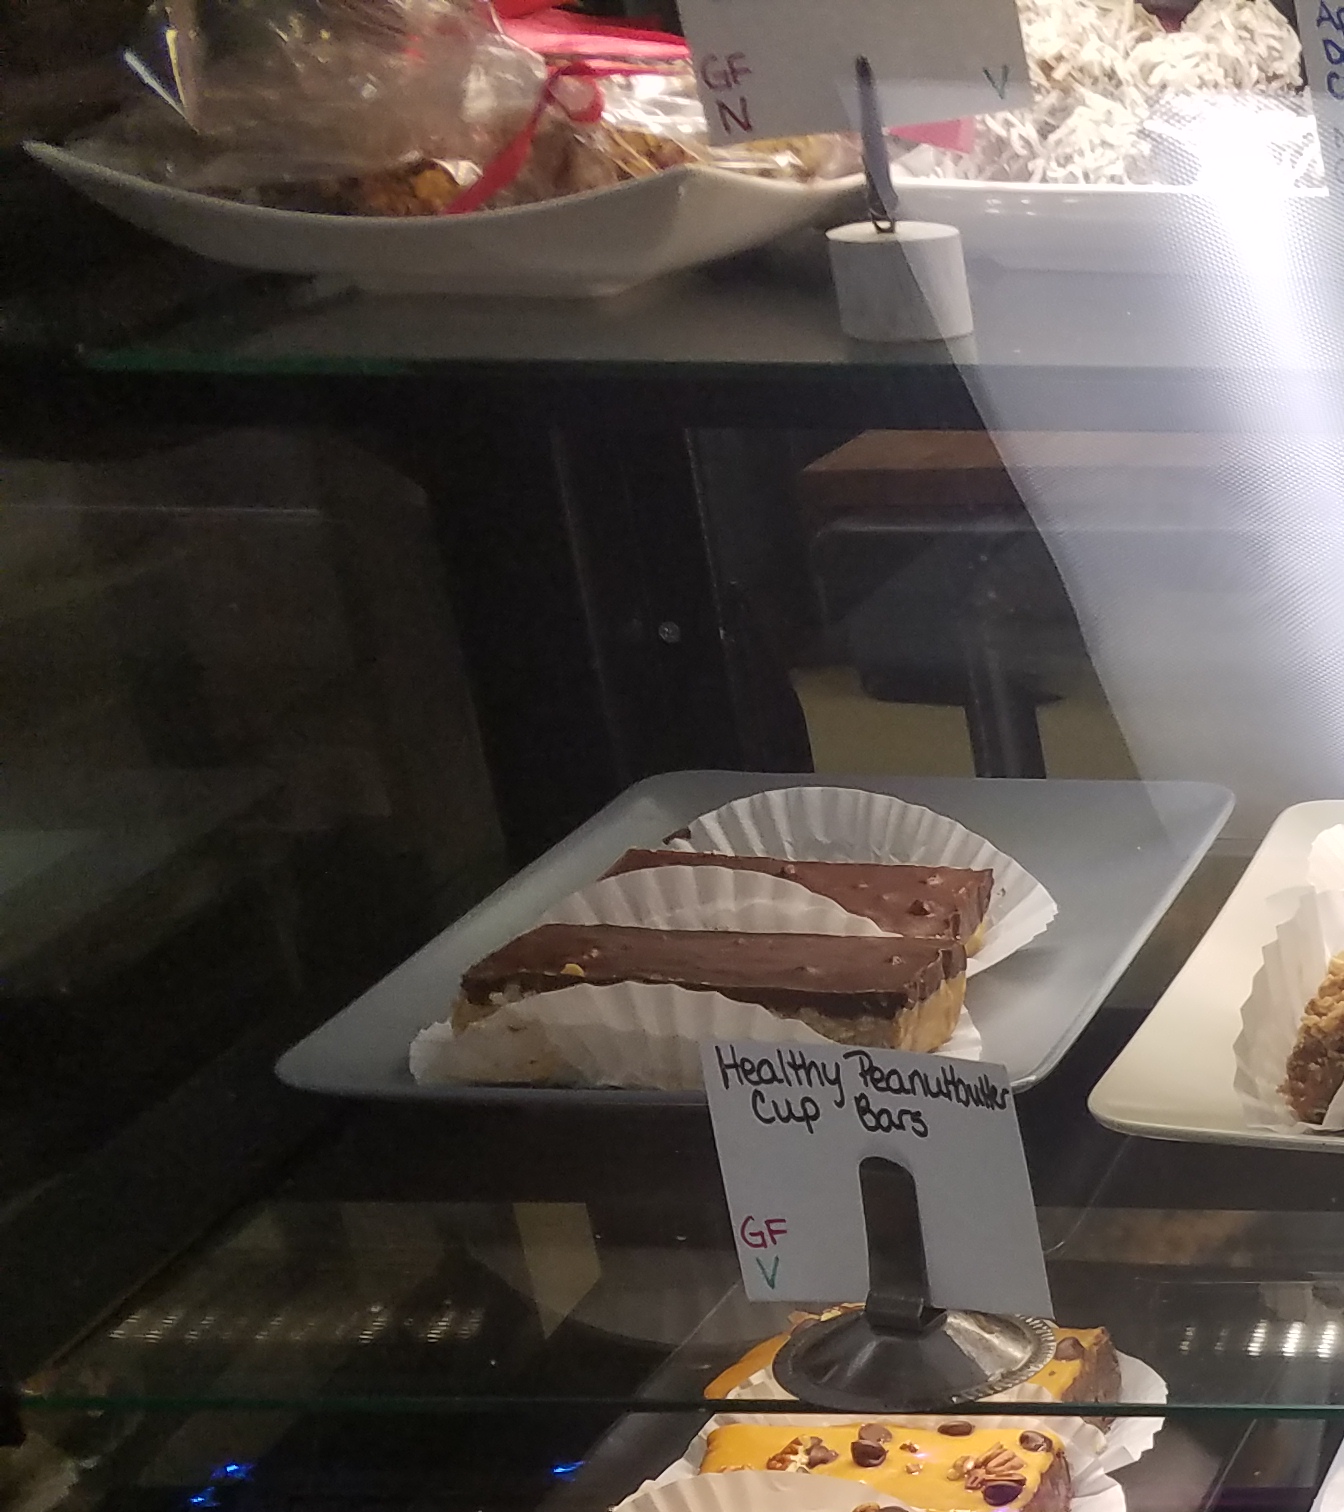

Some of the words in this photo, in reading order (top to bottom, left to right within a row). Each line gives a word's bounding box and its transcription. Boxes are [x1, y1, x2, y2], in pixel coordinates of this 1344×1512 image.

[701, 53, 751, 91] GF
[982, 64, 1009, 100] V
[715, 97, 753, 135] N
[714, 1044, 846, 1109] Healthy
[751, 1088, 821, 1135] Cup
[854, 1092, 928, 1138] Bars
[740, 1215, 788, 1250] GF
[755, 1255, 780, 1291] V
